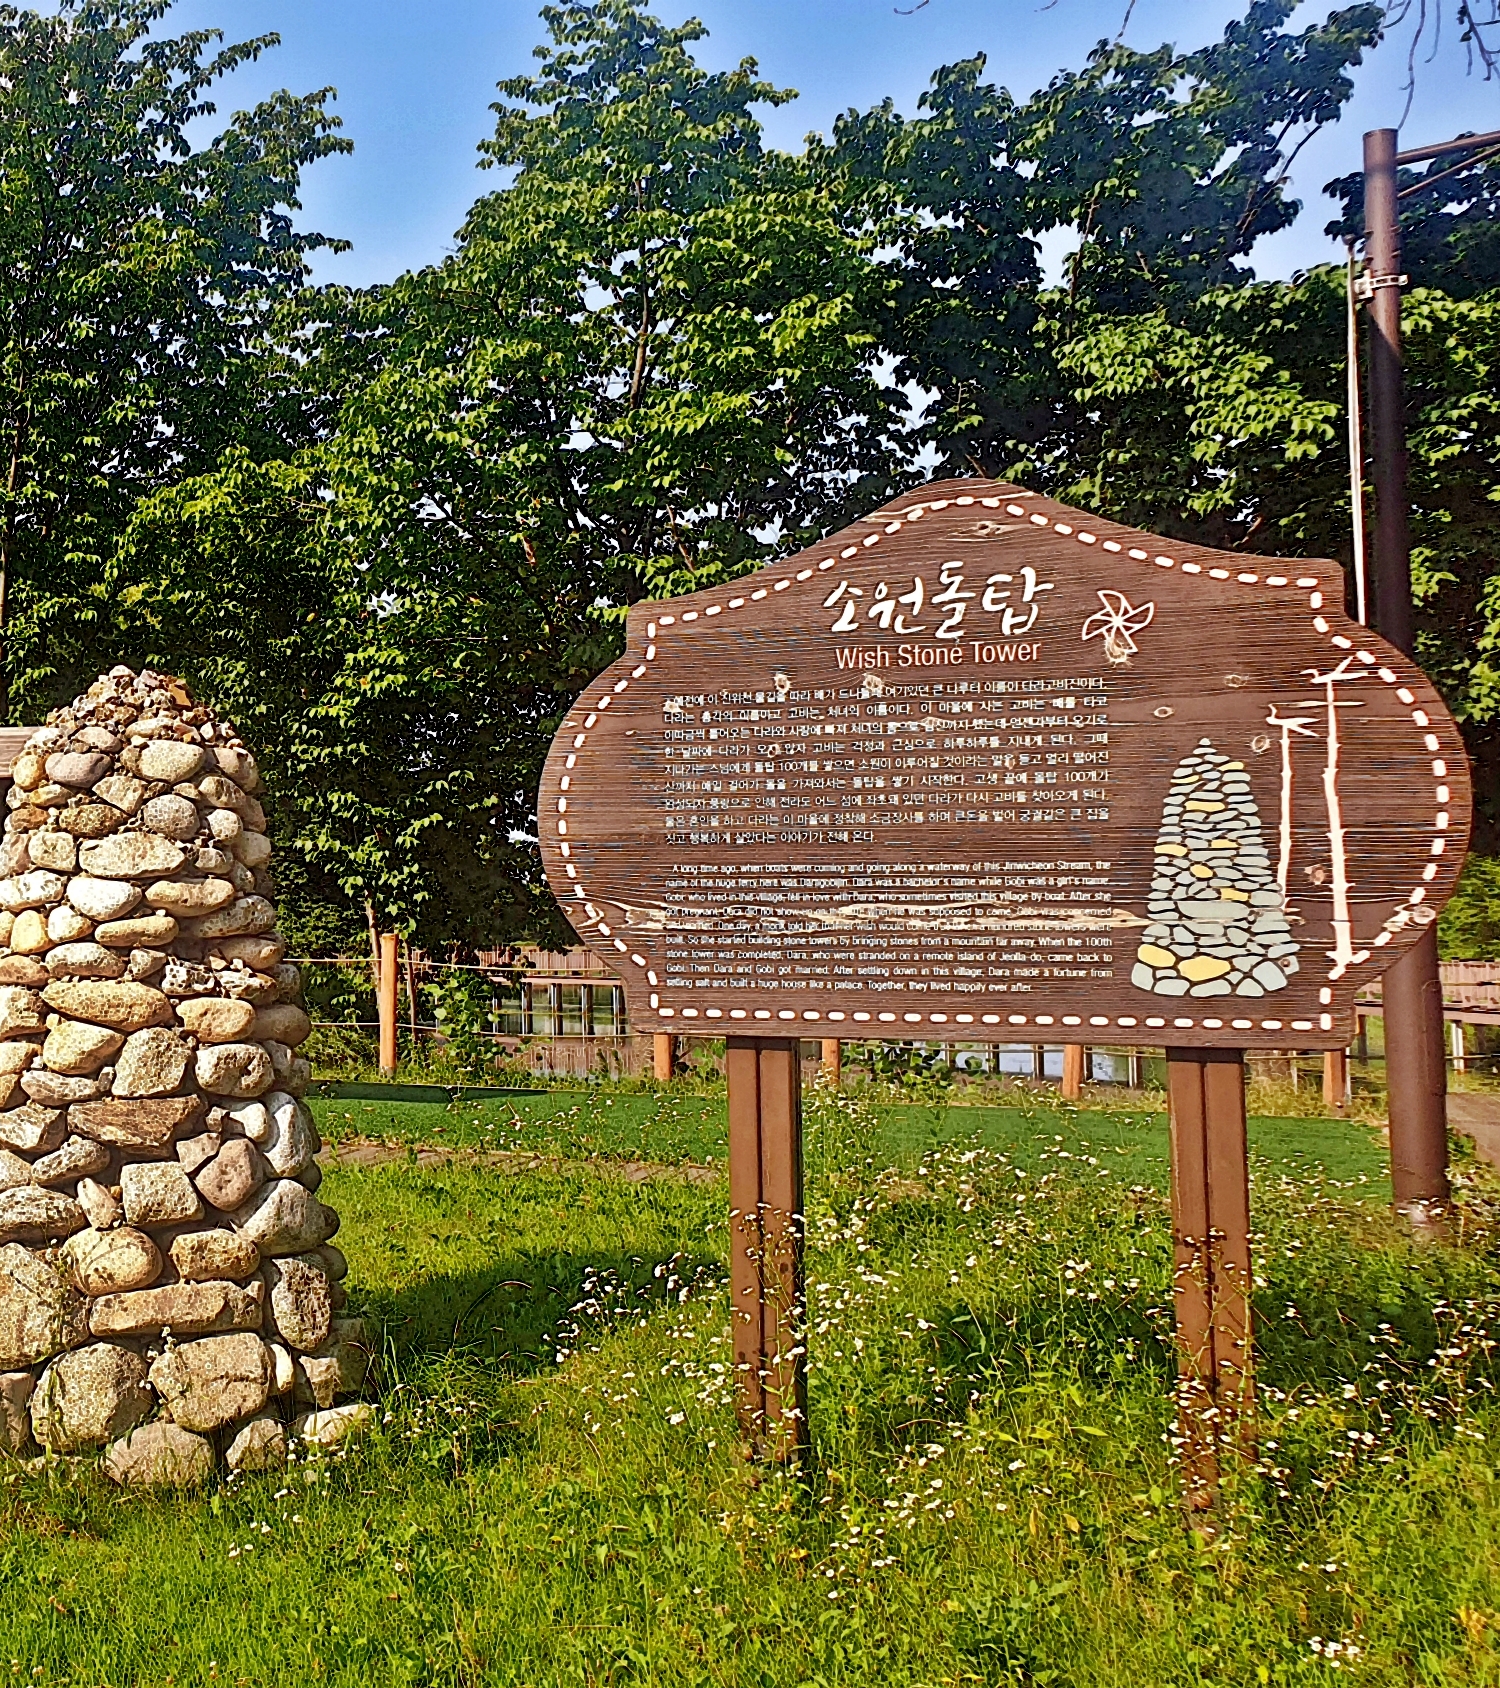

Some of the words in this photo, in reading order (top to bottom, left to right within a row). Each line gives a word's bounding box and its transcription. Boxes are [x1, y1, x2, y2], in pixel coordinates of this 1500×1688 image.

[823, 561, 1054, 638] 소원돌탑
[836, 646, 890, 669] Wish
[898, 643, 963, 666] Stone
[970, 641, 1042, 662] Tower
[889, 936, 919, 945] stones
[920, 936, 941, 945] from
[1038, 937, 1065, 945] When
[1067, 937, 1083, 945] the
[1085, 937, 1113, 945] 100th
[812, 951, 830, 959] who
[858, 951, 896, 959] stranded
[922, 951, 954, 960] remote
[957, 952, 984, 960] island
[1076, 952, 1100, 961] back
[689, 963, 710, 972] Then
[736, 964, 752, 972] and
[755, 964, 775, 973] Gobi
[777, 964, 792, 975] got
[833, 965, 854, 973] After
[892, 965, 917, 974] down
[932, 966, 950, 974] this
[988, 966, 1011, 975] Dara
[1013, 967, 1040, 975] made
[1053, 967, 1087, 976] fortune
[1090, 967, 1113, 976] from
[712, 978, 728, 986] and
[908, 981, 928, 991] they
[930, 981, 952, 990] lived
[953, 981, 986, 992] happily
